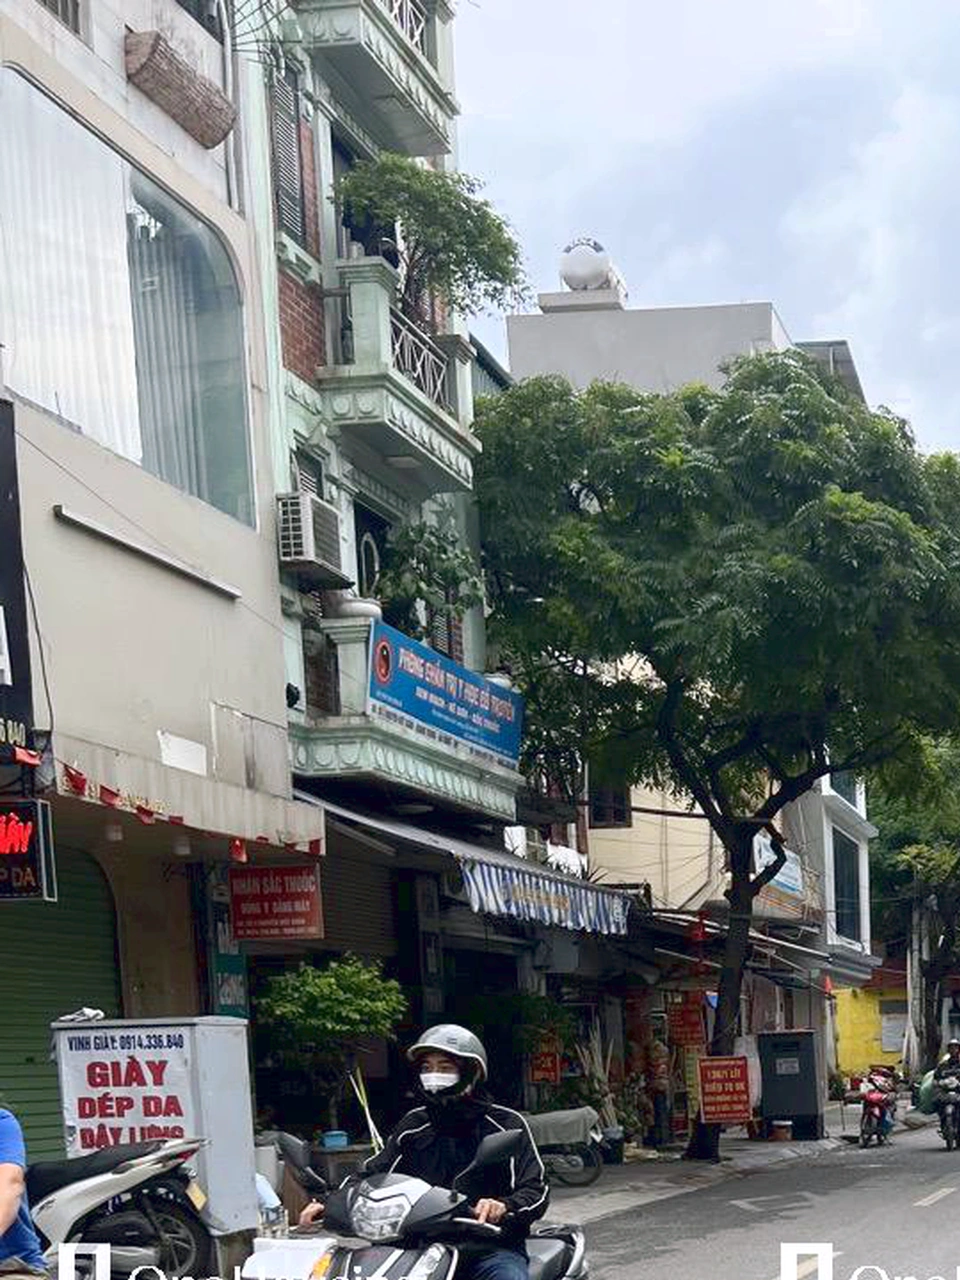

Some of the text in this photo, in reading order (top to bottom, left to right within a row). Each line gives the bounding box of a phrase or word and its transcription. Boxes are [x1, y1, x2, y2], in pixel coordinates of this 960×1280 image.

[12, 867, 35, 887] DA
[86, 1055, 168, 1089] GIÀY
[77, 1092, 184, 1119] DÉP DA
[80, 1123, 123, 1149] DÂY
